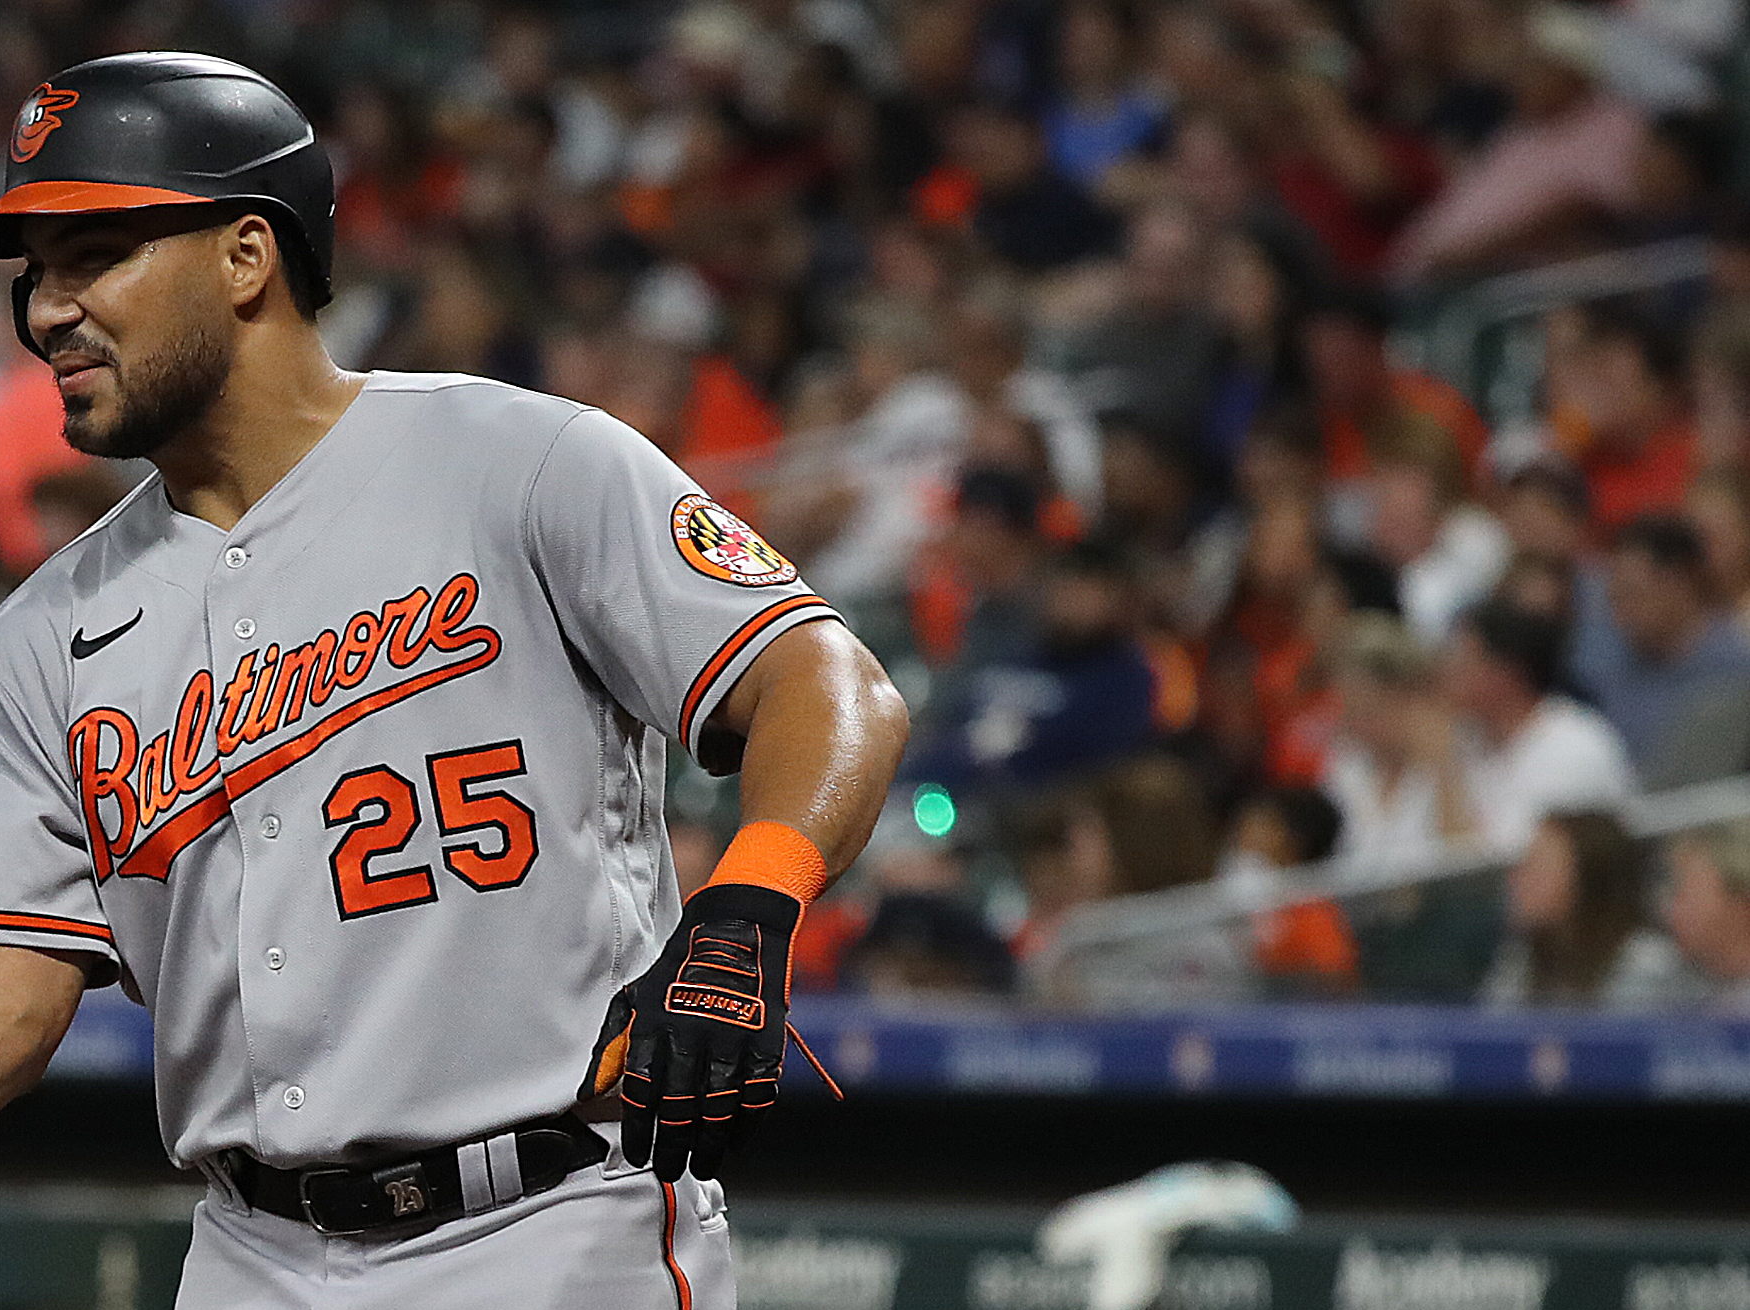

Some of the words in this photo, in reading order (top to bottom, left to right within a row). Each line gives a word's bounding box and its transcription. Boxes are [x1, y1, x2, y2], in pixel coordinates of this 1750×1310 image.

[67, 572, 502, 887] Baltimore
[321, 738, 540, 921] 25
[672, 990, 762, 1022] Franklin
[384, 1176, 425, 1217] 25
